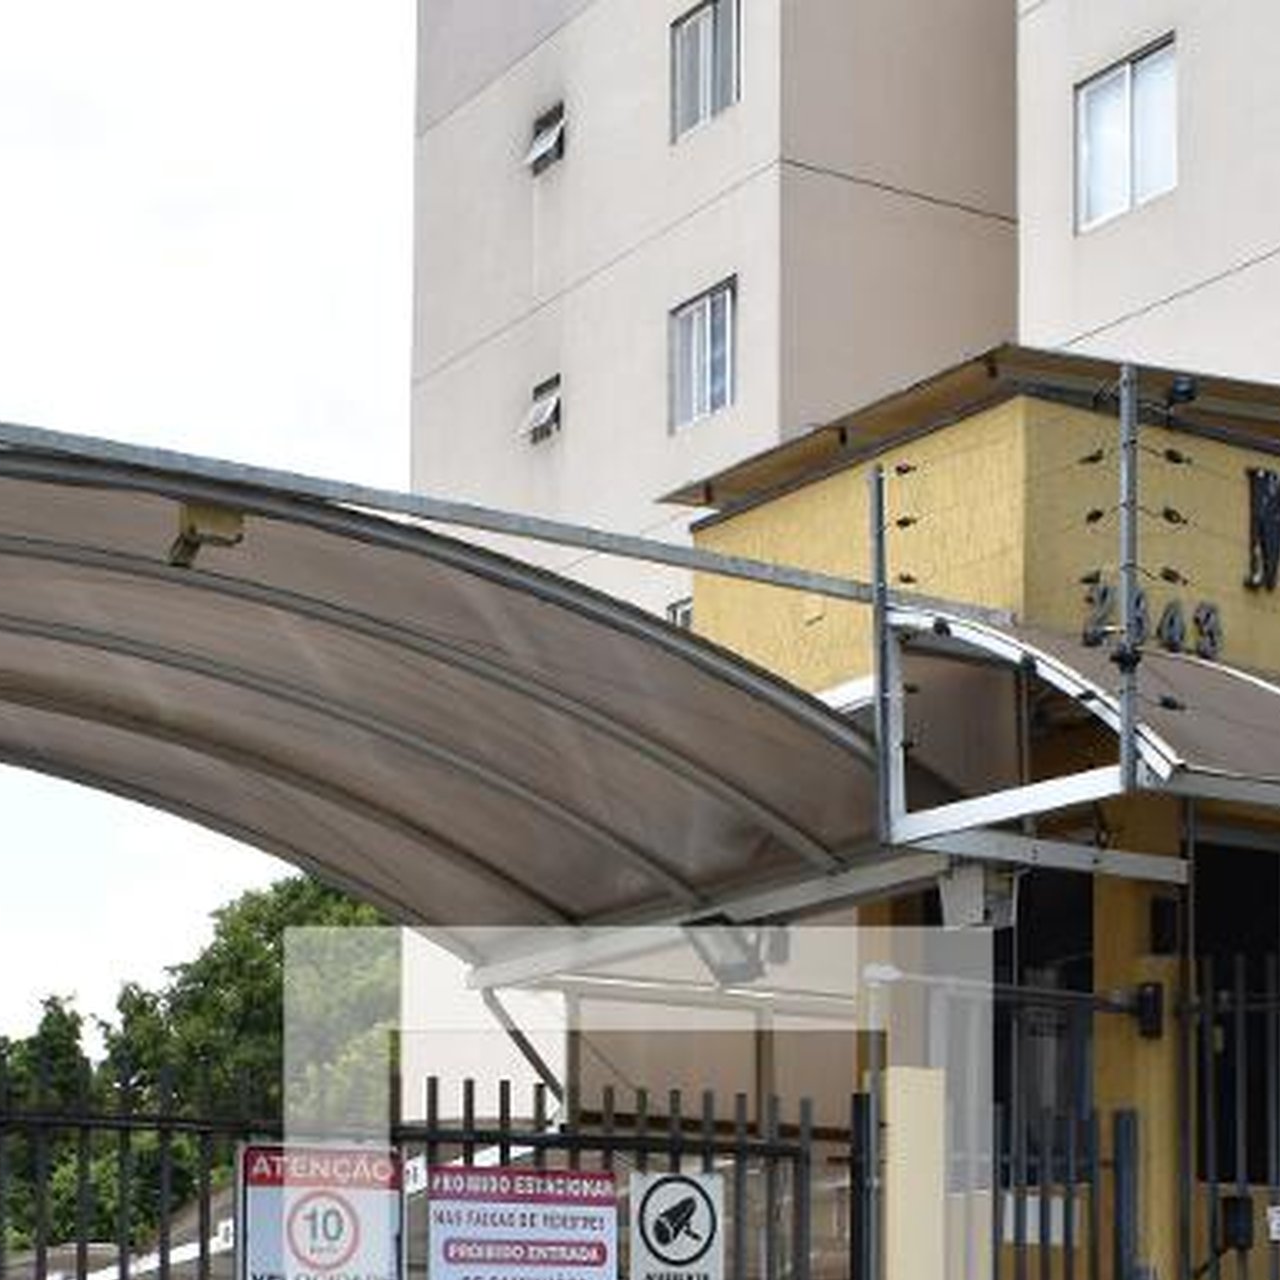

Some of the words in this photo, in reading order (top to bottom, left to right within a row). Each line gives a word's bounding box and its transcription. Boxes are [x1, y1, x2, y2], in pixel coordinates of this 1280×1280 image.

[252, 1153, 394, 1183] ATENÇÃO
[432, 1174, 511, 1194] PROIBIDO
[514, 1175, 615, 1198] ESTACIONAR
[303, 1207, 344, 1242] 10
[448, 1243, 525, 1260] PROIBIDO
[527, 1245, 599, 1261] ENTRADA
